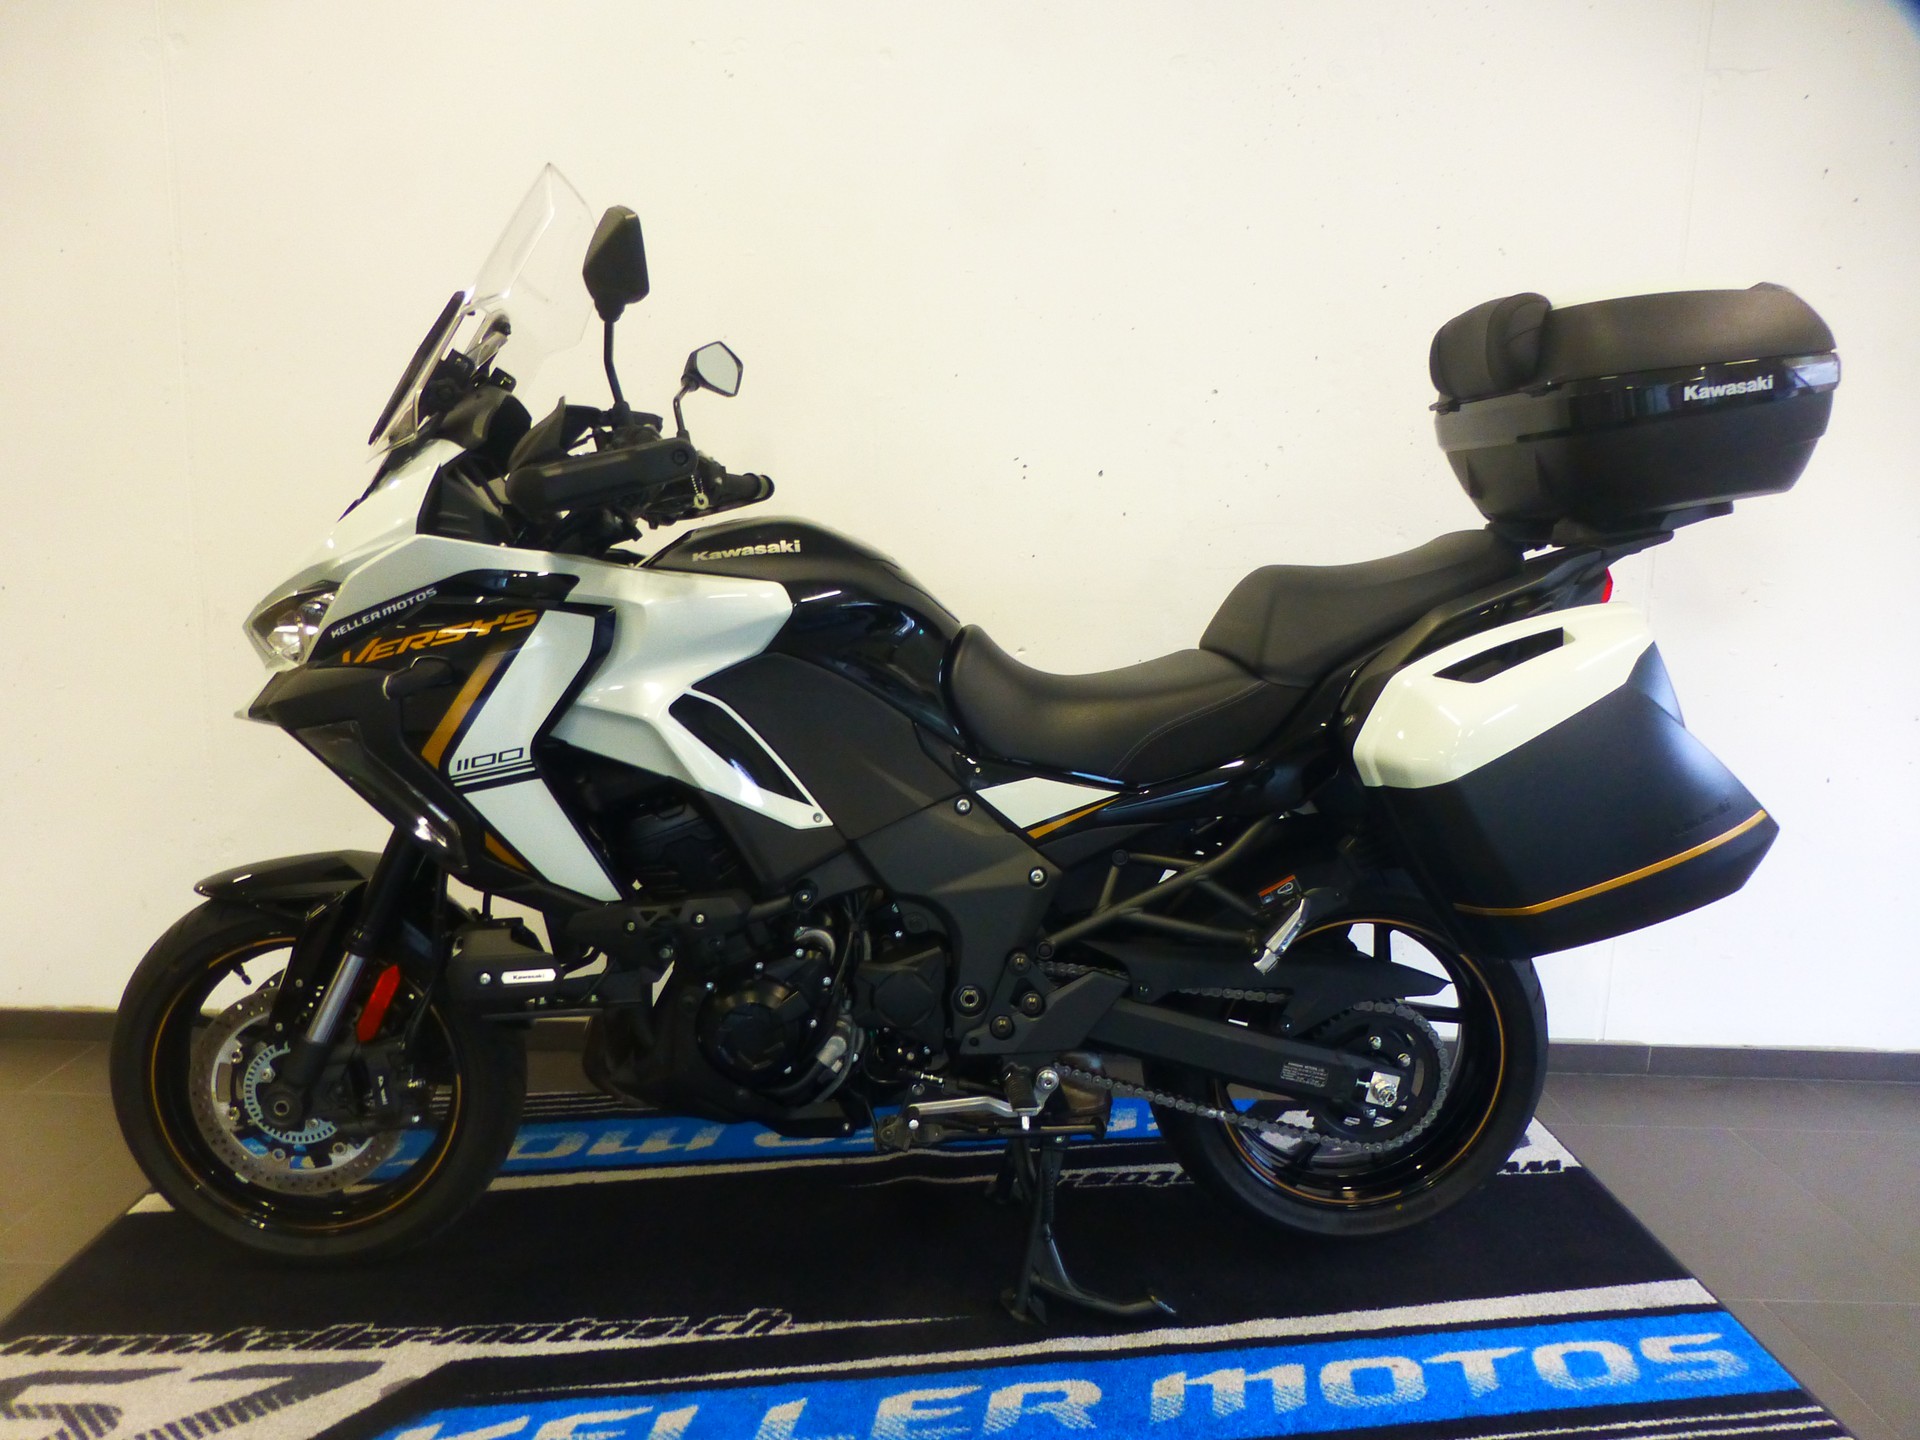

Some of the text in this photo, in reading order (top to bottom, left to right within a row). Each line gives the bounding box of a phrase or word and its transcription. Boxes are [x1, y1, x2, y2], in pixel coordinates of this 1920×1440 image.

[1683, 374, 1774, 401] Kawasaki
[692, 539, 801, 562] Kawasaki
[331, 587, 438, 639] KELLER MOTOS
[341, 608, 539, 664] VERSYS
[457, 747, 524, 772] 1100
[1149, 1332, 1749, 1424] MOTOS
